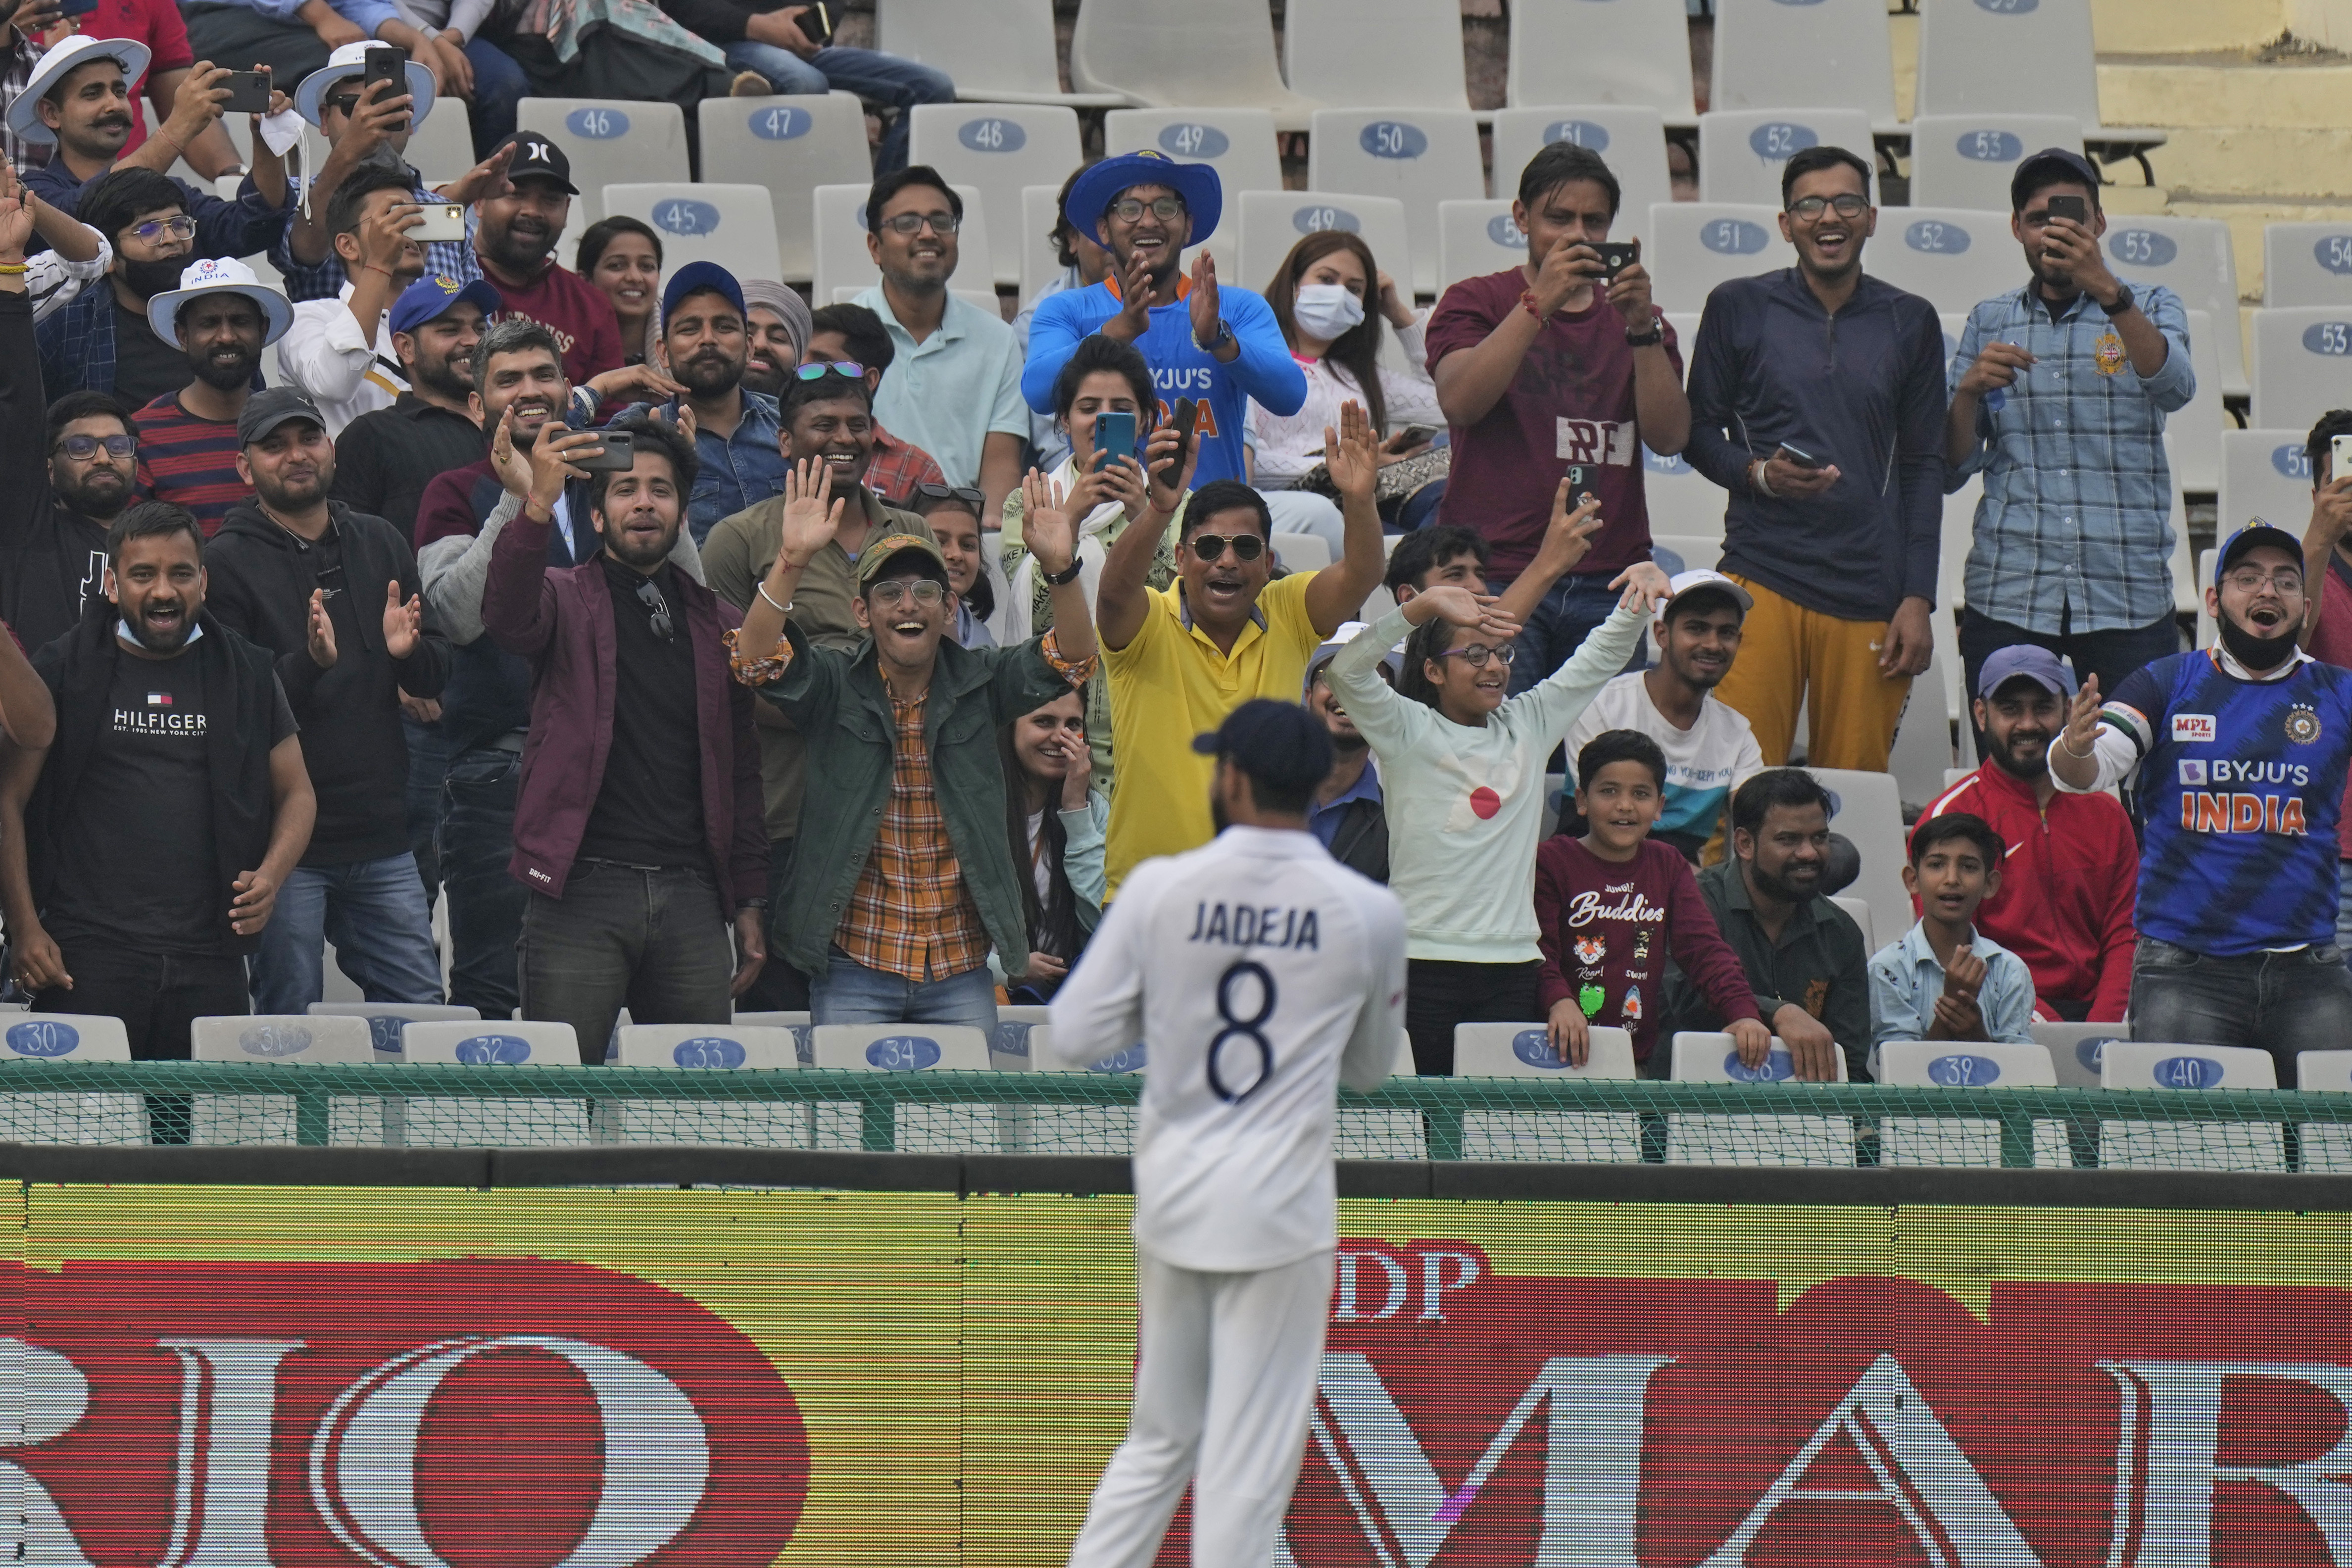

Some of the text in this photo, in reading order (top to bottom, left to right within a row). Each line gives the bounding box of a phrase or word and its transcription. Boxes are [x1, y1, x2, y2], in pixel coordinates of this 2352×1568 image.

[584, 110, 610, 136] 46
[766, 109, 791, 137] 47
[976, 120, 1003, 148] 48
[1176, 125, 1203, 152] 49
[1377, 123, 1403, 153] 50
[1768, 126, 1792, 152] 52
[1976, 132, 2000, 157] 53
[667, 203, 695, 230] 45
[1308, 208, 1335, 232] 49
[1719, 222, 1740, 249] 51
[1922, 223, 1944, 249] 52
[2125, 232, 2152, 260] 53
[192, 273, 229, 285] INDIA
[2323, 324, 2347, 355] 53
[1148, 367, 1212, 390] YJU'S
[114, 709, 206, 730] HILFIGER
[2176, 719, 2211, 732] MPL
[2213, 760, 2309, 786] BYJU'S
[2181, 792, 2309, 835] INDIA
[529, 868, 551, 883] DRI-FIT
[1568, 890, 1664, 927] Buddies
[1190, 901, 1319, 951] JADEJA
[26, 1023, 57, 1051] 30
[261, 1026, 282, 1052] 31
[374, 1018, 402, 1047] 34
[1001, 1024, 1028, 1050] 37
[1204, 959, 1277, 1104] 8
[476, 1038, 505, 1064] 32
[693, 1040, 724, 1069] 33
[886, 1039, 915, 1068] 34
[2172, 1059, 2201, 1086] 40
